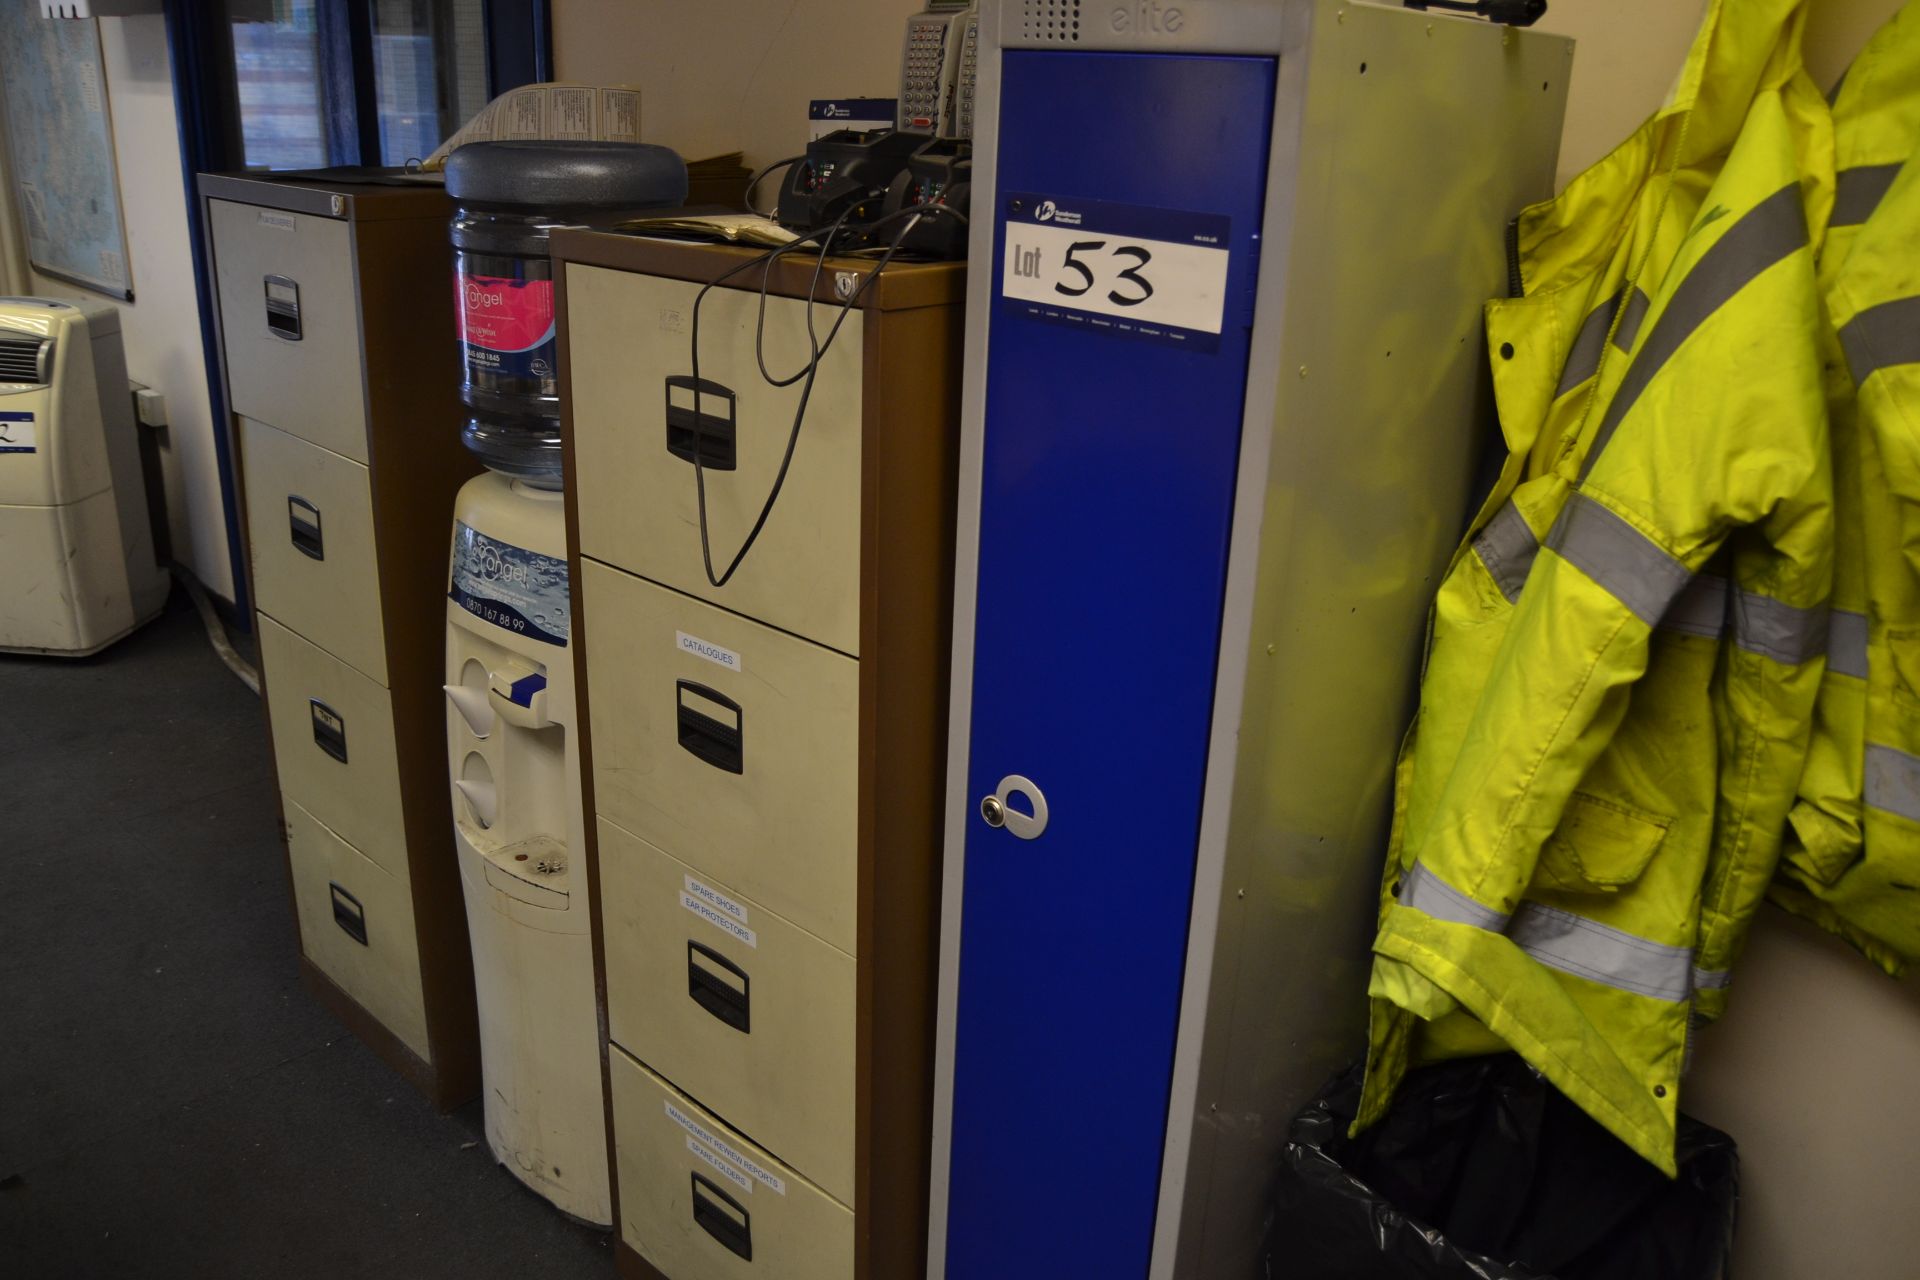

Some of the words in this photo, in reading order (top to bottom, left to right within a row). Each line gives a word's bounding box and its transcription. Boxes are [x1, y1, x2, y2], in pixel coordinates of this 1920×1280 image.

[1111, 1, 1184, 32] elite
[1014, 244, 1041, 279] Lot
[1055, 241, 1154, 307] 53
[470, 291, 503, 308] angel
[486, 556, 527, 582] angel
[466, 598, 482, 614] 0870
[484, 606, 497, 620] 167
[499, 614, 510, 626] 88
[513, 618, 525, 631] 99
[683, 638, 733, 664] CATALOGUES
[691, 882, 714, 902] SPARE
[716, 896, 741, 917] SHOES
[685, 897, 700, 912] EAR
[701, 907, 750, 941] PROTECTORS
[668, 1107, 713, 1144] MANAGEMENT
[714, 1139, 743, 1165] REVIEW
[744, 1160, 778, 1188] REPORTS
[692, 1142, 713, 1164] SPARE
[714, 1158, 746, 1186] FOLDERS
